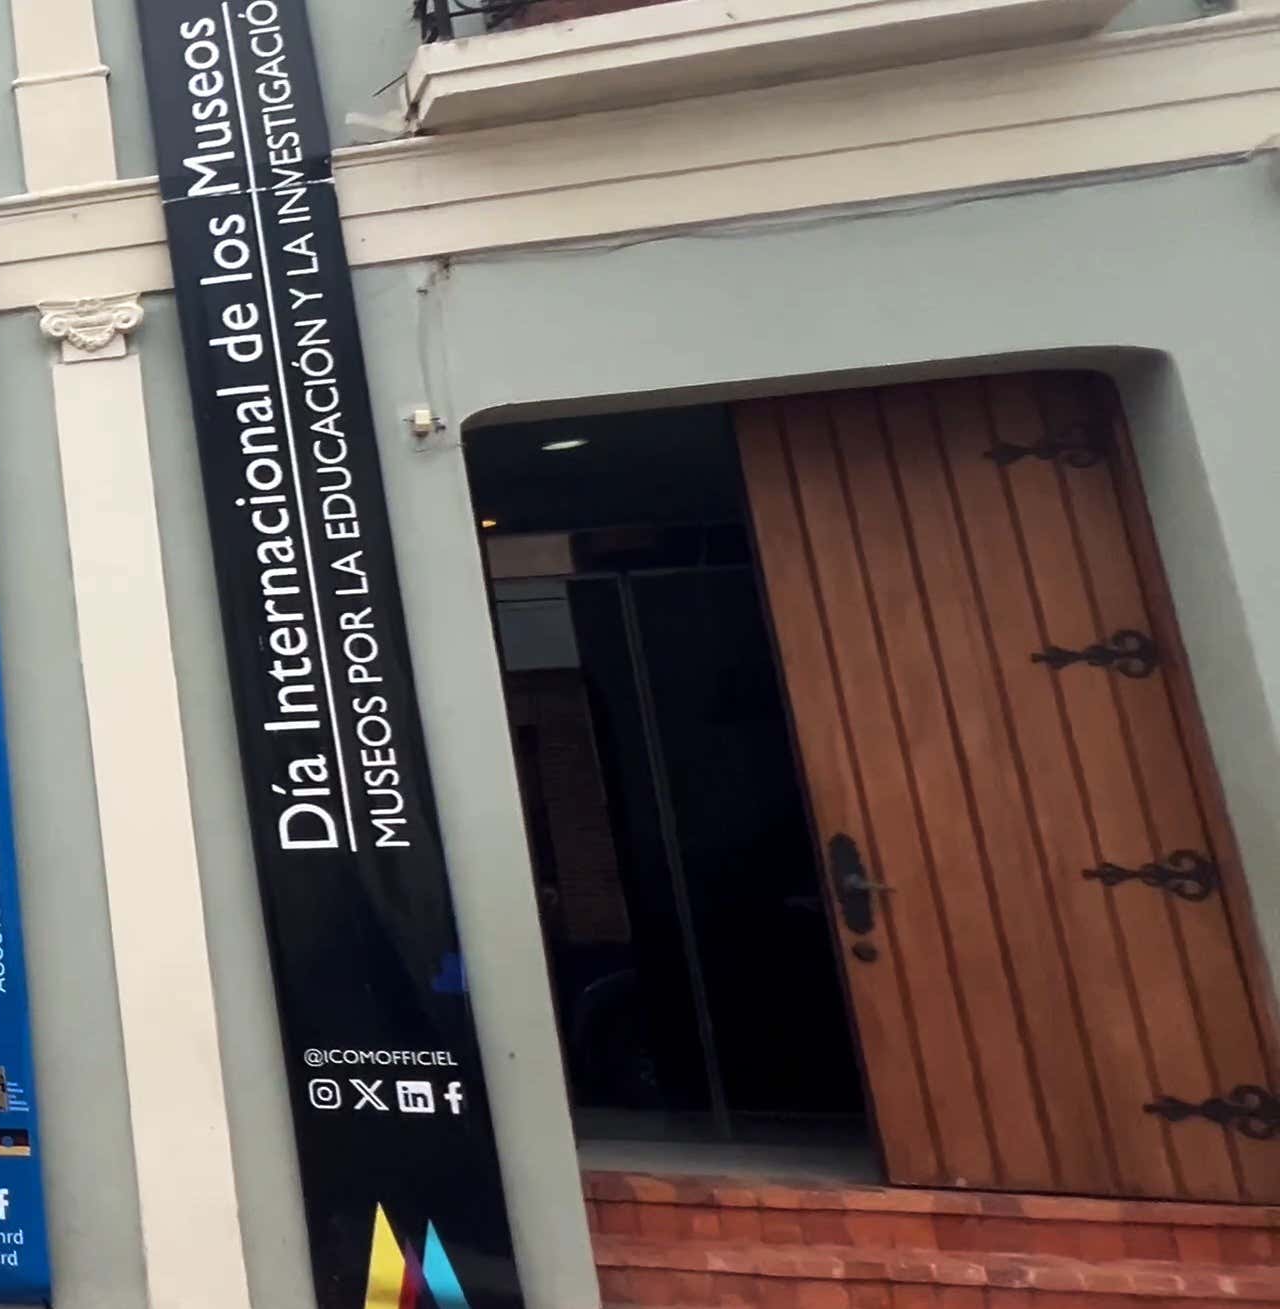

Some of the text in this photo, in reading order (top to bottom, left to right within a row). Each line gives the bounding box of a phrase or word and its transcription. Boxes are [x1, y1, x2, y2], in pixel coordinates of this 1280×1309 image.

[180, 17, 339, 850] Día Internacional de los Museos
[237, 0, 410, 848] MUSEOS POR LA EDUCACIÓN Y LA INVESTIGACIÓ
[303, 1048, 458, 1067] @ICOMOFFICIEL
